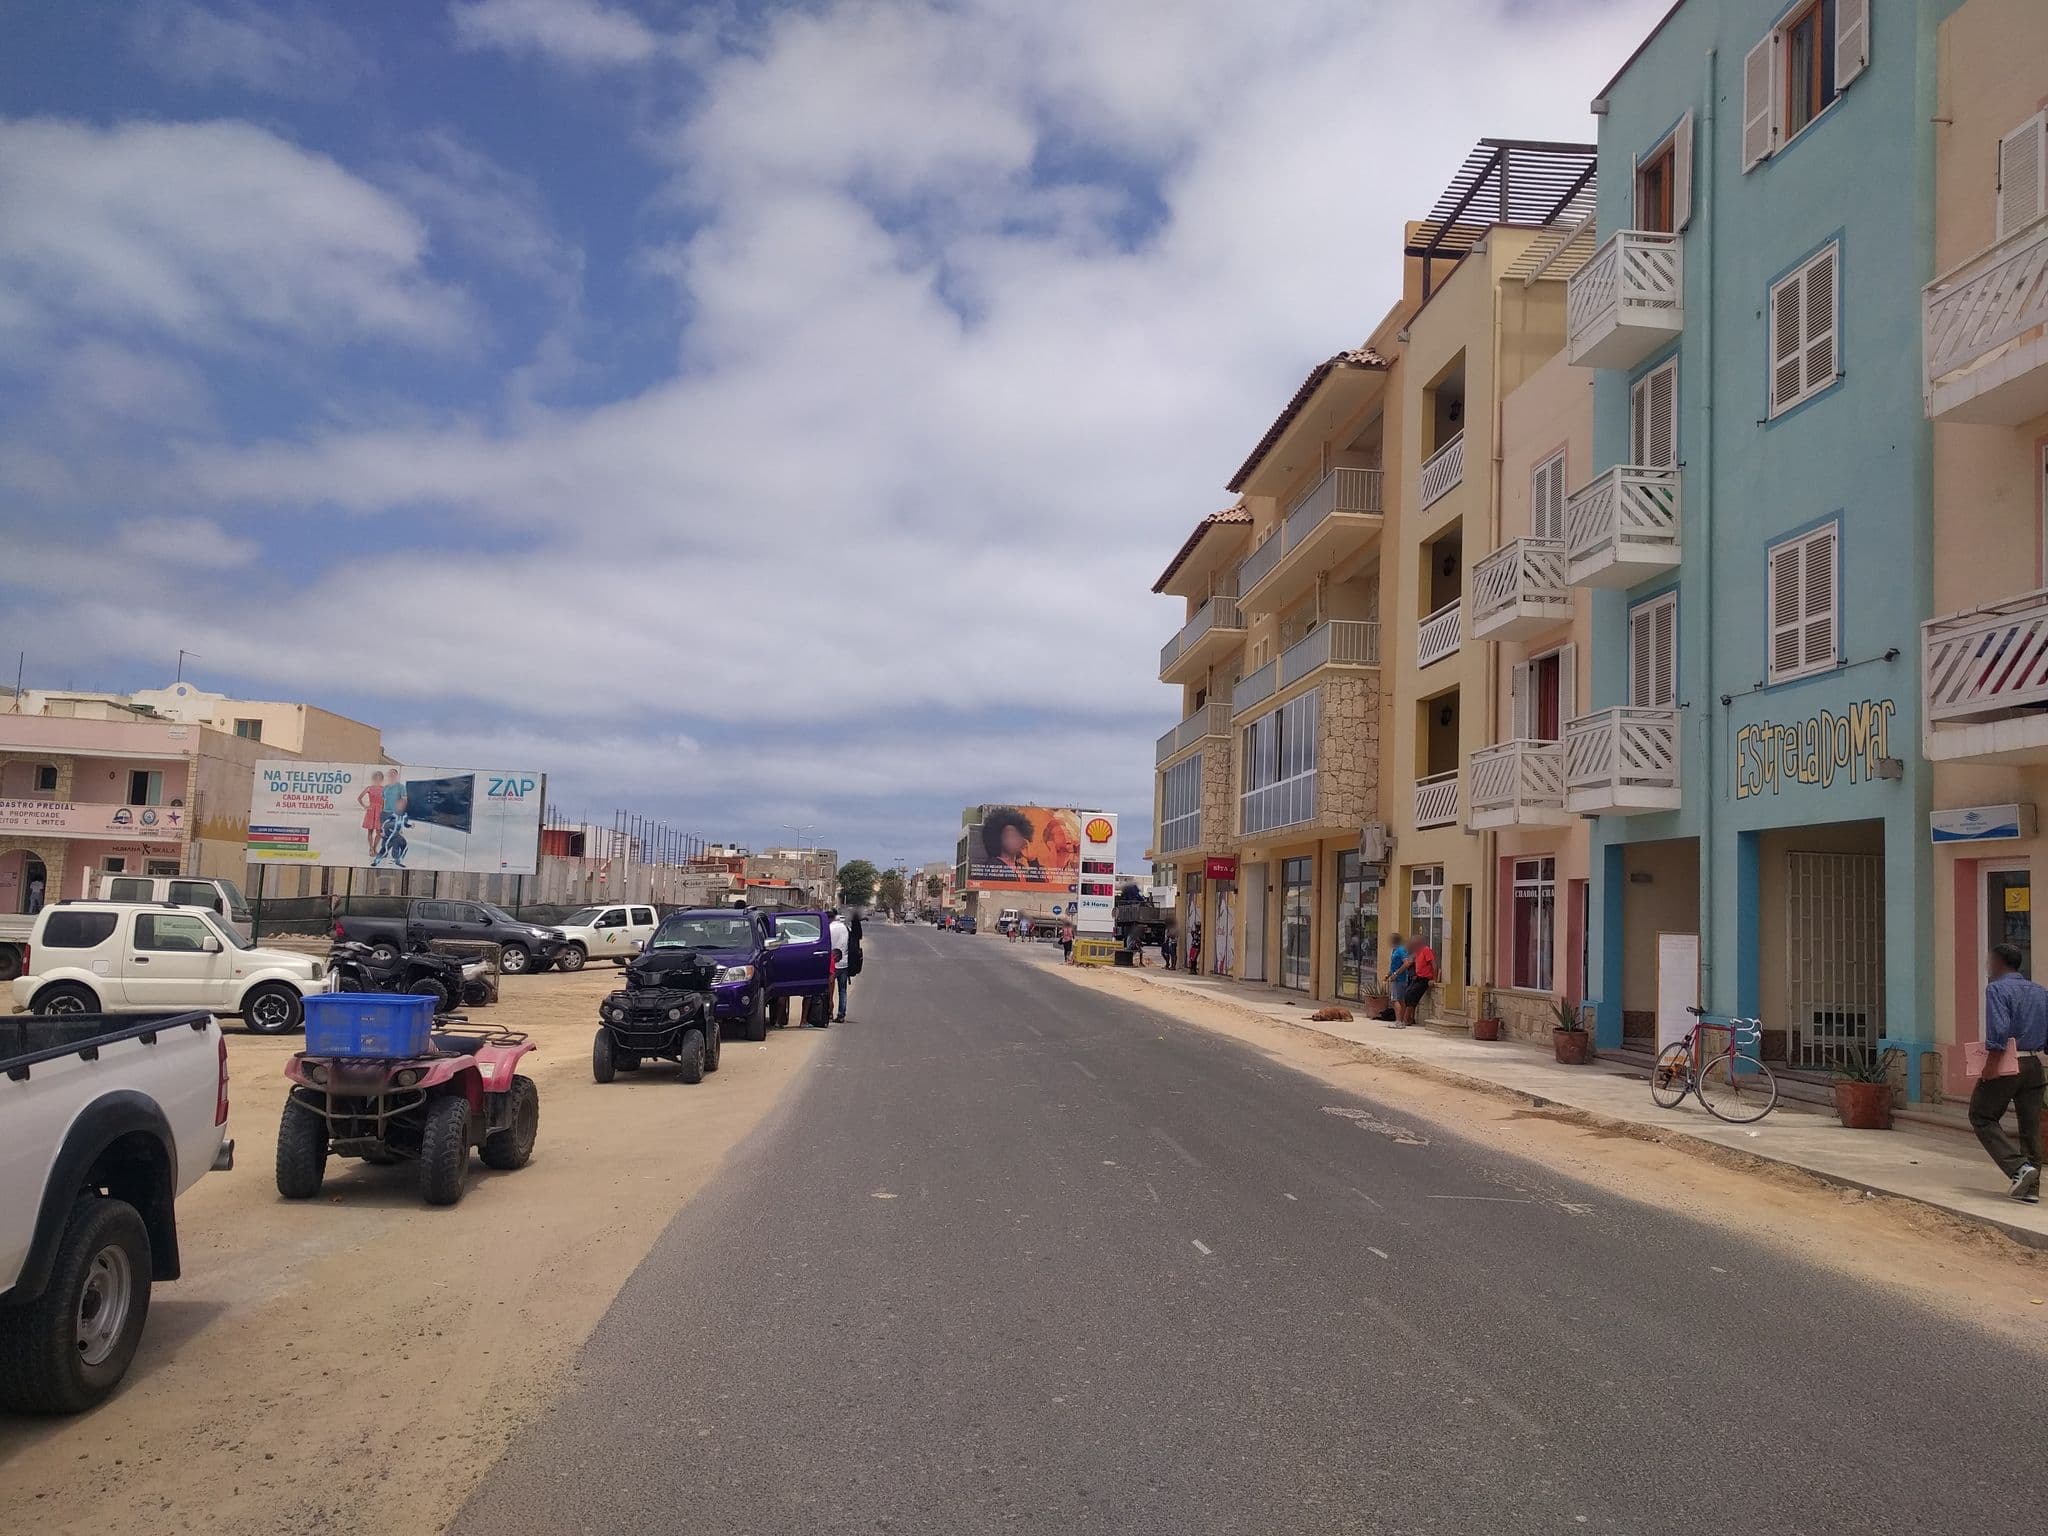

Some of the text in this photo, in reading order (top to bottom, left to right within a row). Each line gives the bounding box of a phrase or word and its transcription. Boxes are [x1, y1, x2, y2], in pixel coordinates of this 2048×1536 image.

[264, 769, 352, 784] NA TELEVISÃO
[270, 781, 343, 794] DO FUTURO
[488, 777, 535, 797] ZAP
[282, 793, 300, 801] CADA
[37, 802, 76, 811] PREDIAL
[10, 810, 61, 819] PROPRIEDADE
